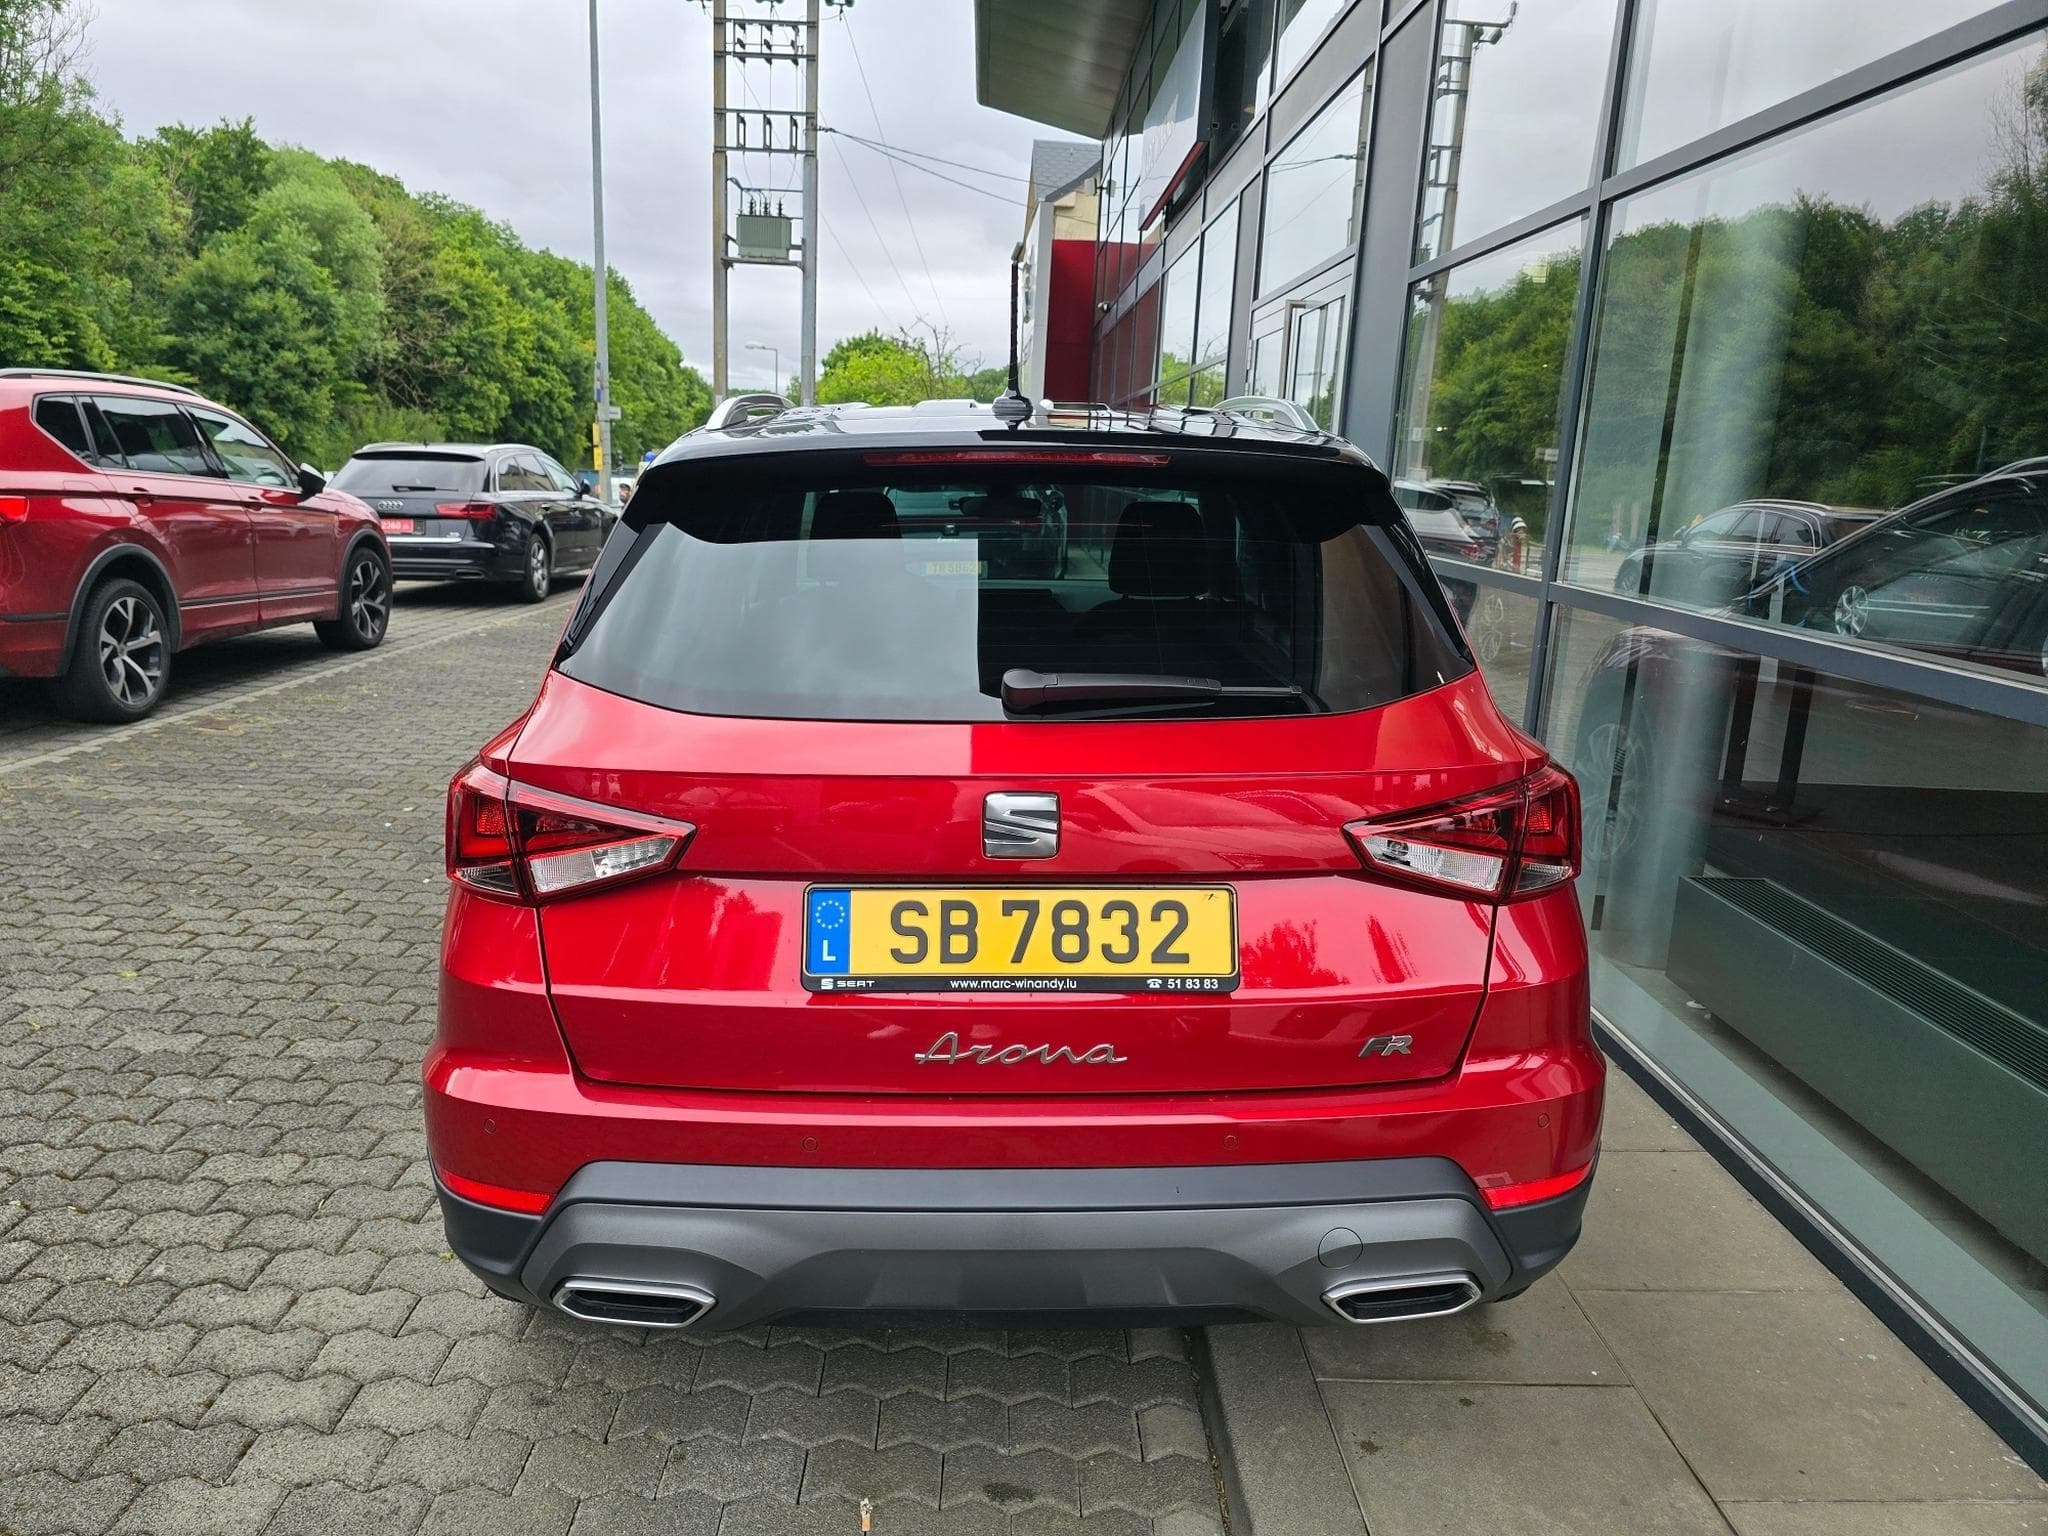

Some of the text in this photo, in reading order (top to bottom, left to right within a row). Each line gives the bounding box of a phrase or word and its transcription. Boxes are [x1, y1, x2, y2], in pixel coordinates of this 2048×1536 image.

[890, 899, 1189, 964] SB 7832
[821, 939, 836, 962] L
[836, 980, 876, 988] SEAT
[949, 978, 1077, 991] www.marc-winandy.lu
[1167, 978, 1219, 989] 51 83 83
[914, 1030, 1128, 1065] Arona
[1358, 1034, 1414, 1057] FR
